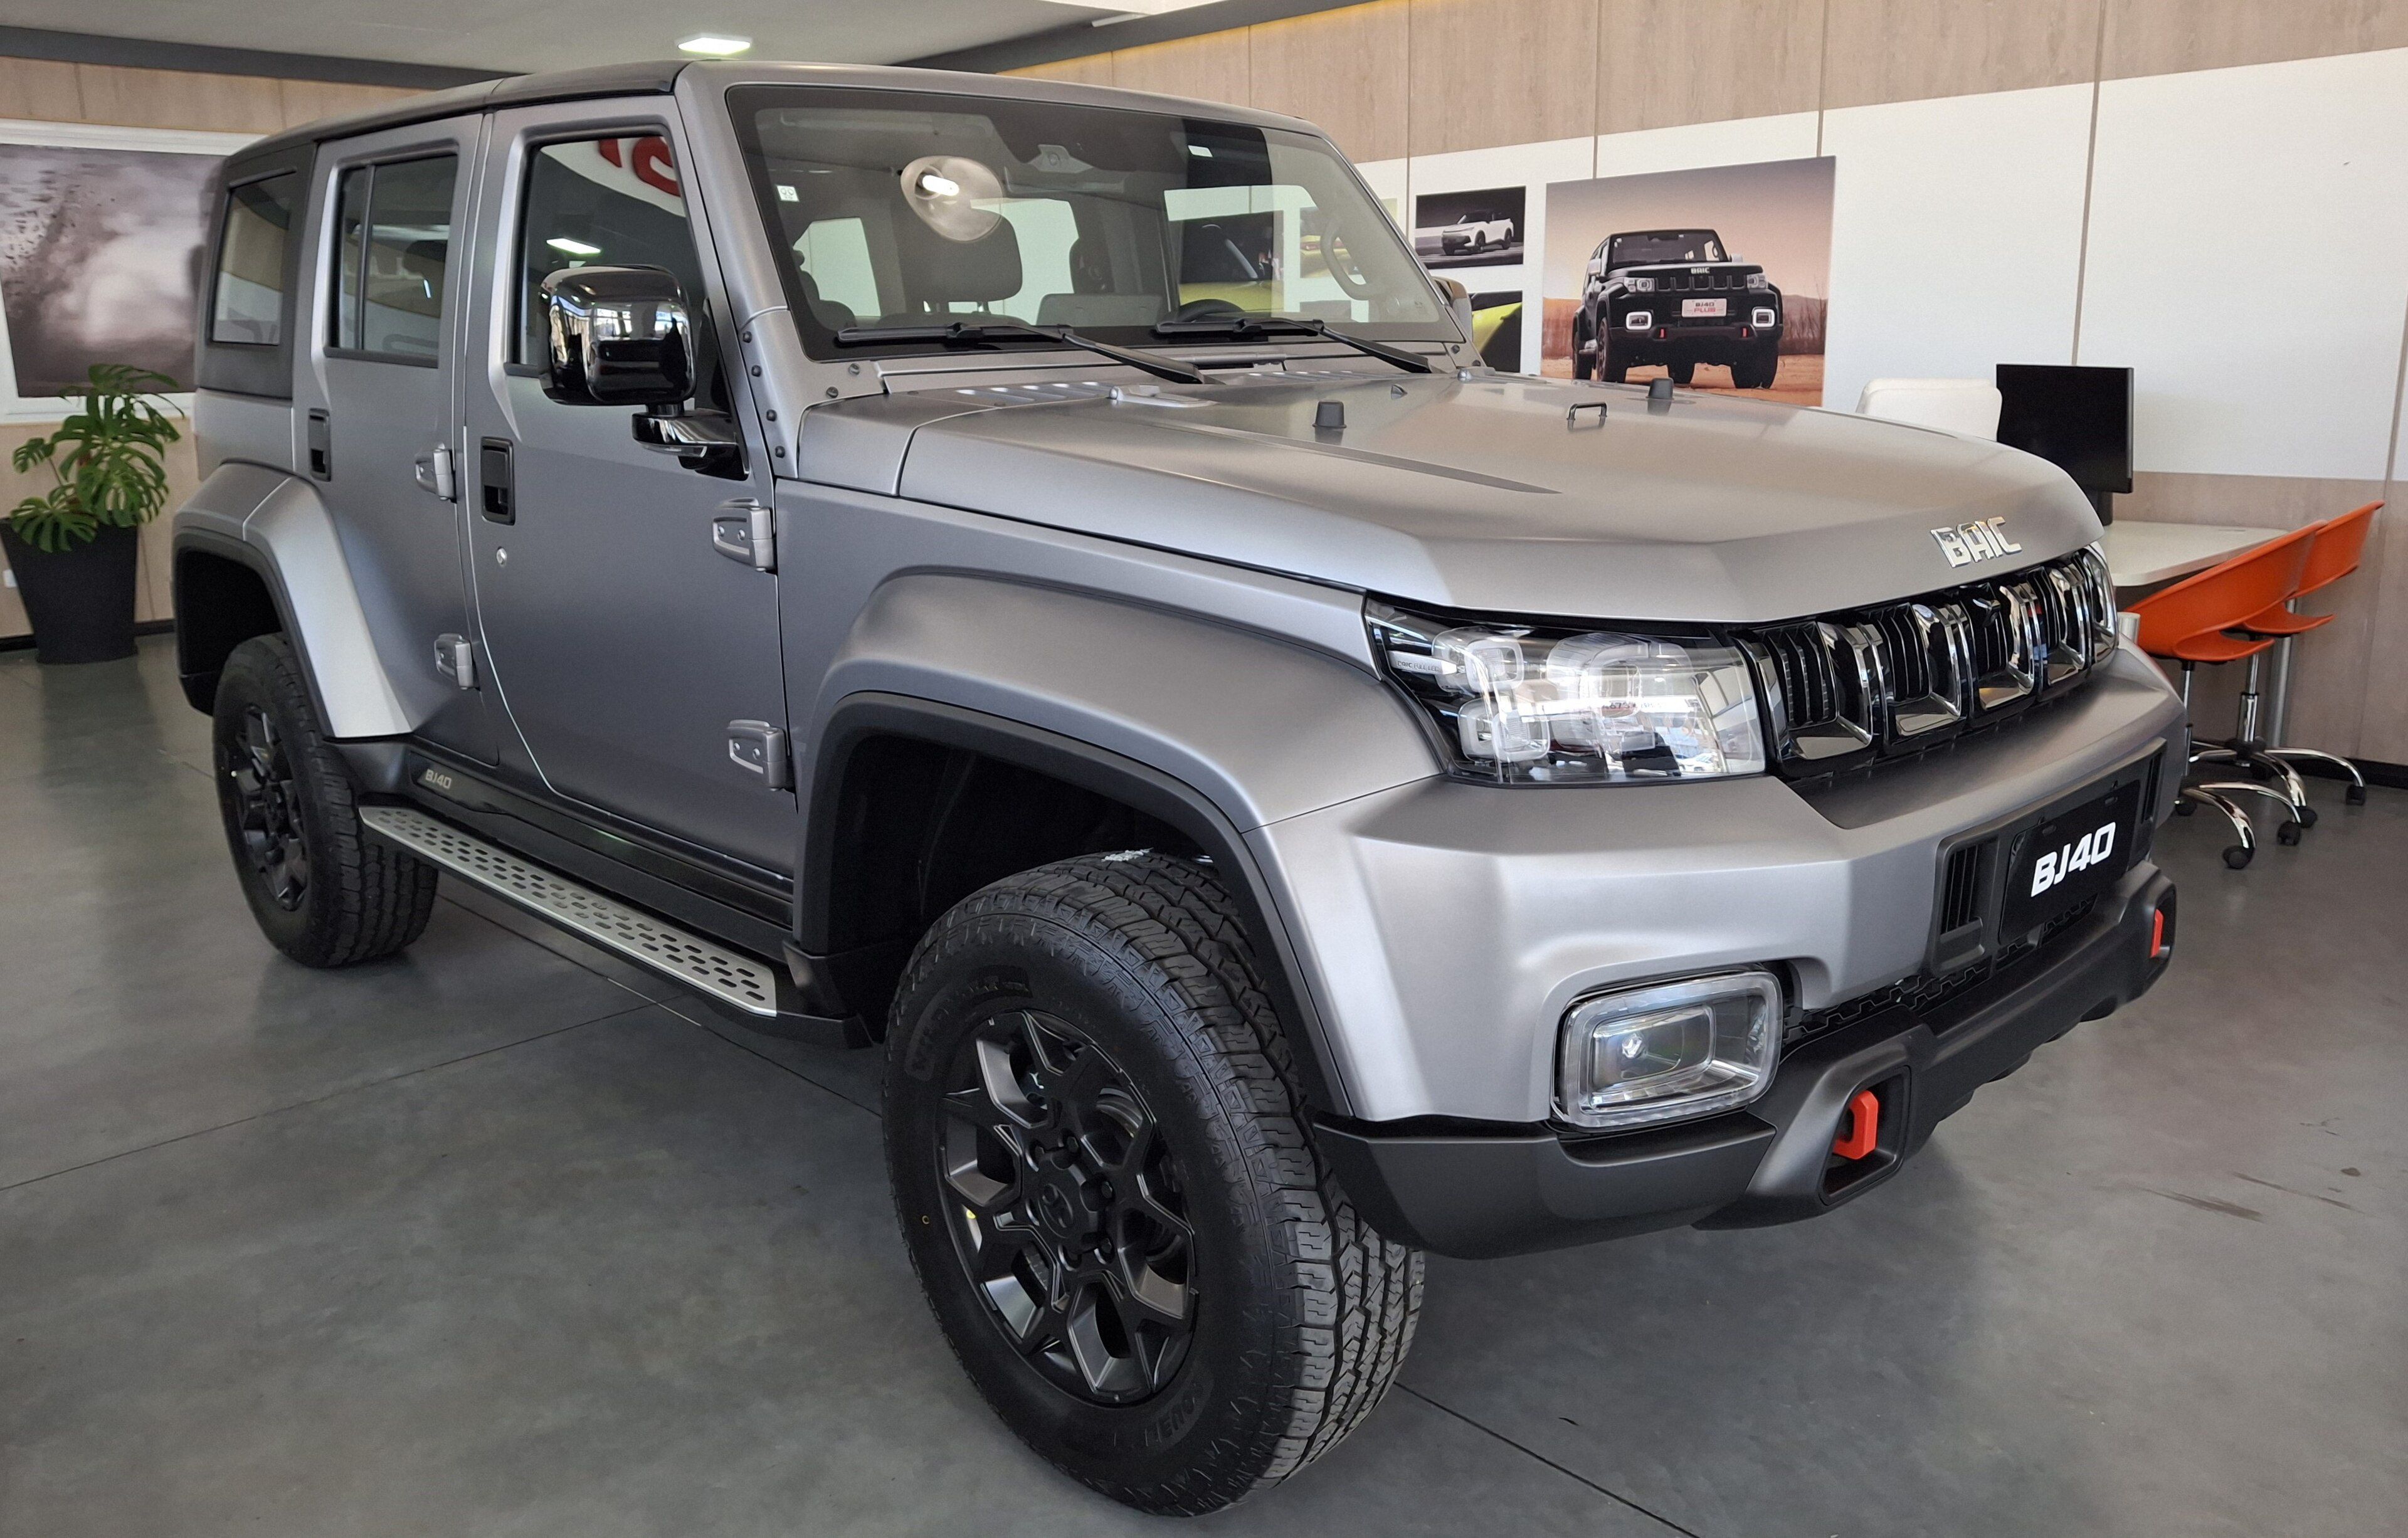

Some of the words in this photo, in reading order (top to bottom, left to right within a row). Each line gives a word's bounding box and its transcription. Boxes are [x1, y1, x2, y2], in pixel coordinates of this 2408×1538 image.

[1930, 516, 2022, 568] BAIC
[425, 768, 452, 789] BJ40
[2030, 821, 2116, 898] BJ40
